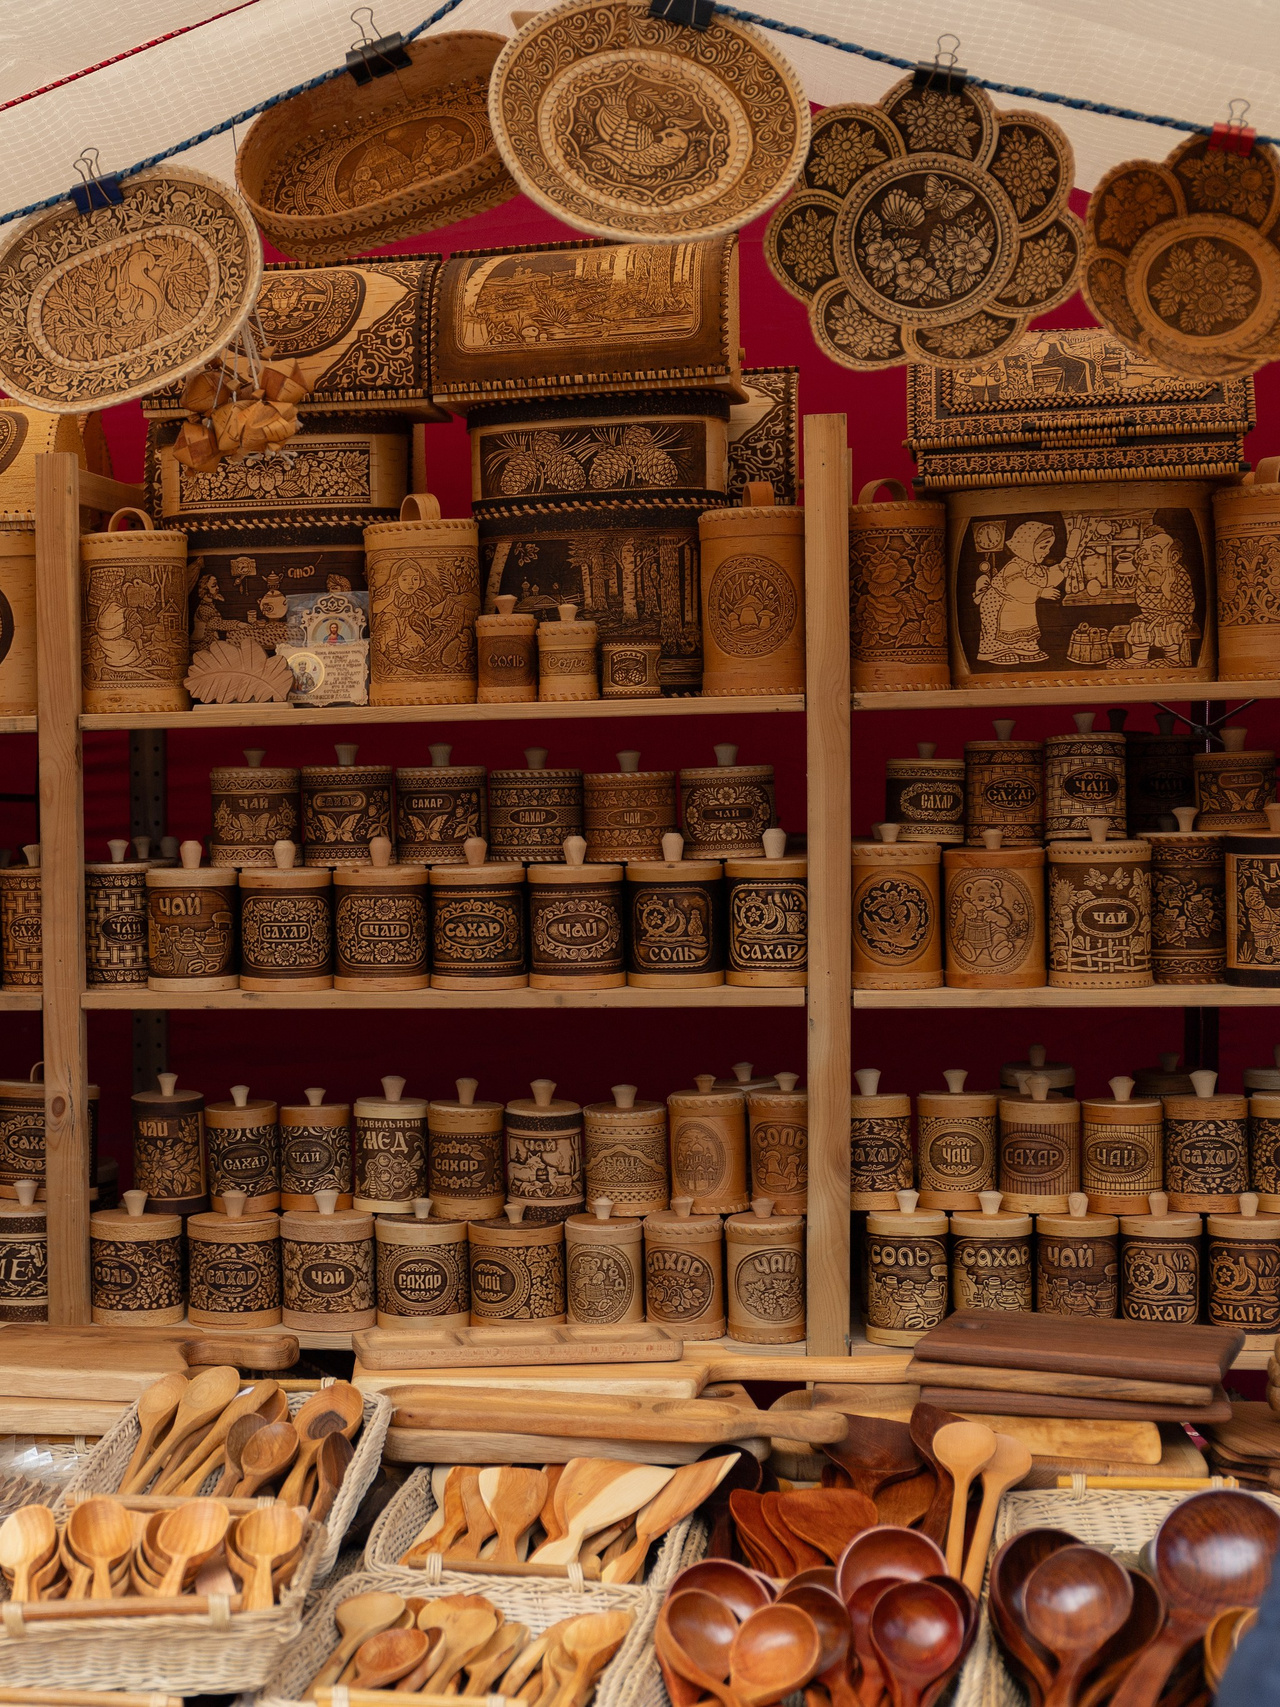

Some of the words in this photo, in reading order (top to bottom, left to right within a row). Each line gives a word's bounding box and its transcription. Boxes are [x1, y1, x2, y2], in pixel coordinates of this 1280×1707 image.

[412, 799, 443, 809] САХАР
[920, 793, 954, 809] САХАР
[520, 811, 547, 823] САХАР
[1092, 910, 1128, 925] ЧАЙ
[11, 925, 41, 939] САХ
[263, 926, 307, 939] САХАР
[649, 946, 696, 962] СОЛЬ
[740, 943, 799, 960] САХАР
[223, 1156, 268, 1171] САХАР
[1005, 1148, 1060, 1167] САХАР
[1096, 1145, 1136, 1168] ЧАЙ
[435, 1159, 479, 1172] САХАР
[206, 1269, 258, 1286] САХАР
[398, 1272, 442, 1290] САХАР
[1128, 1304, 1189, 1322] САХАР
[1223, 1303, 1263, 1323] ЧАЙ
